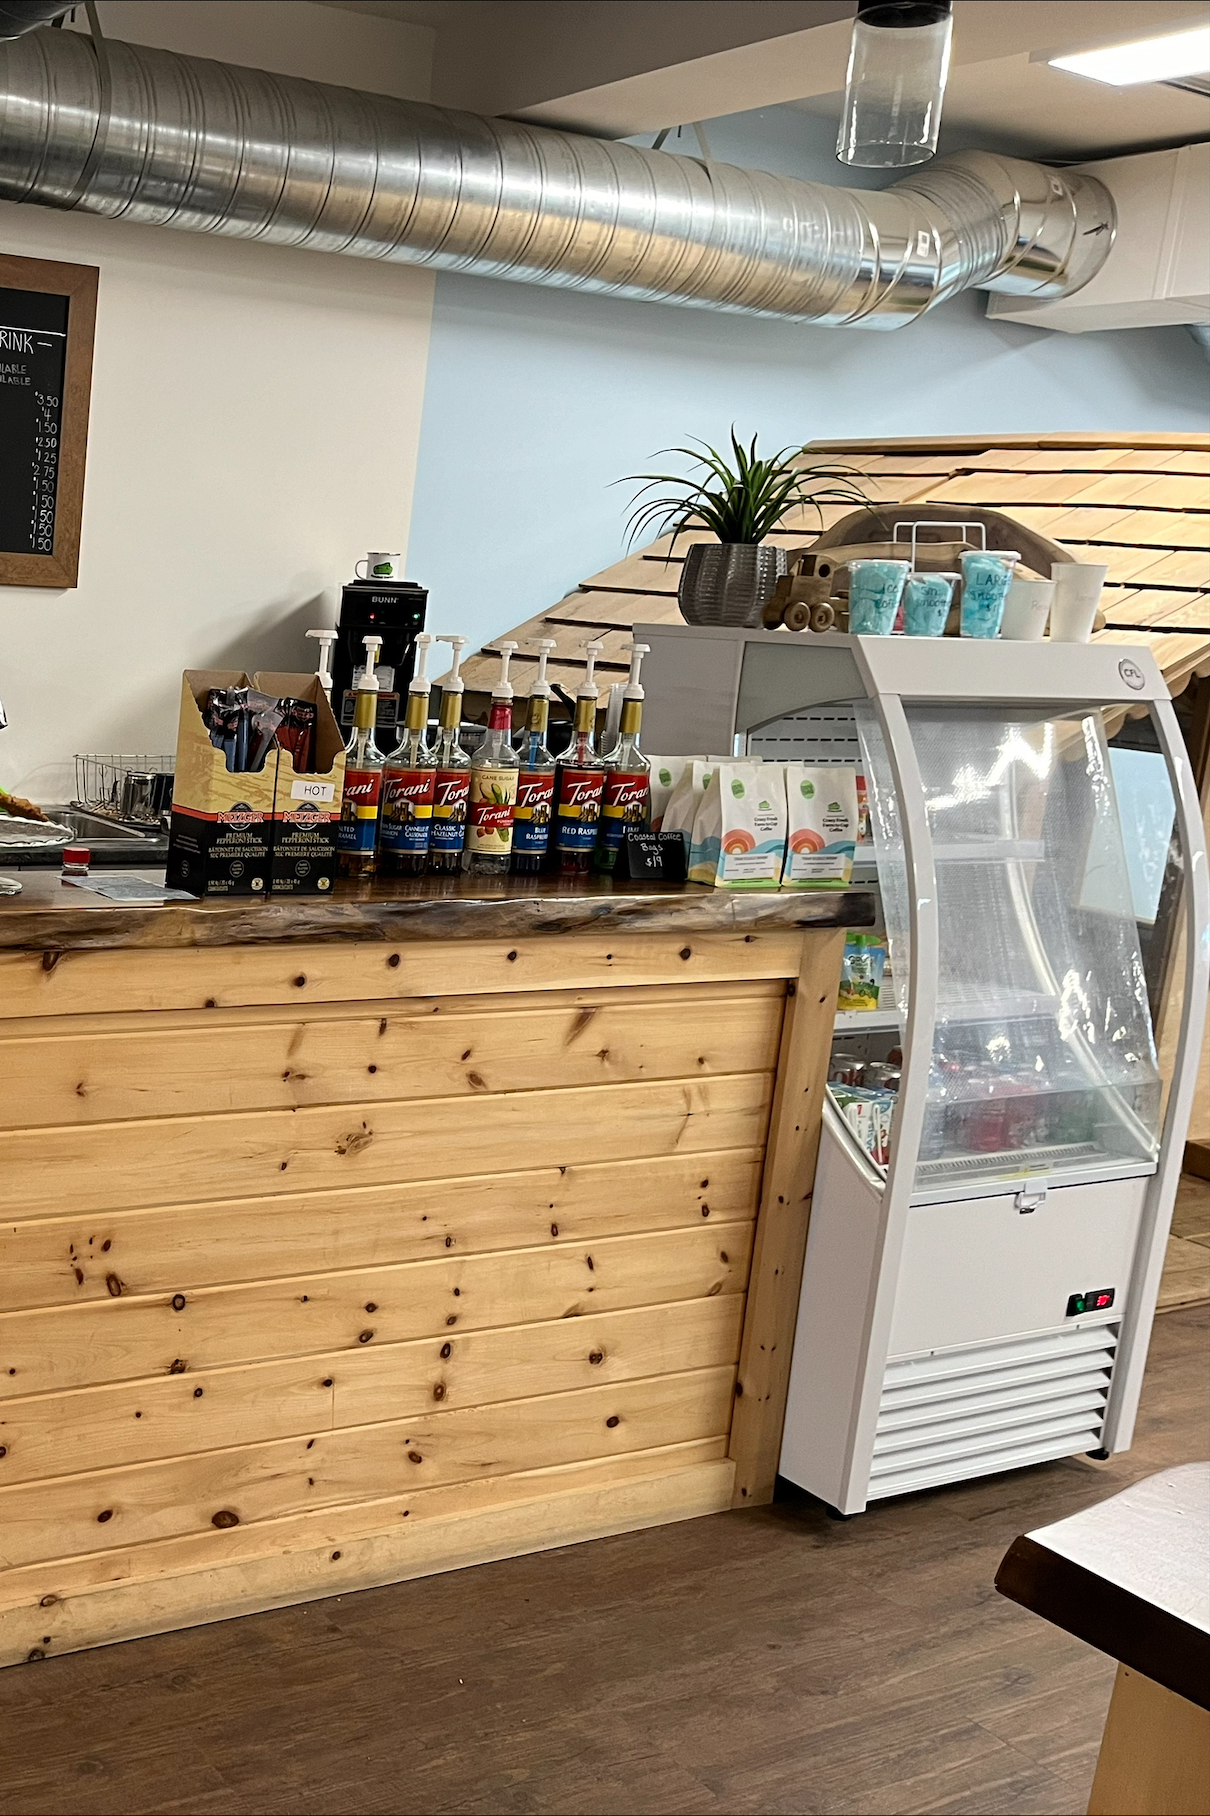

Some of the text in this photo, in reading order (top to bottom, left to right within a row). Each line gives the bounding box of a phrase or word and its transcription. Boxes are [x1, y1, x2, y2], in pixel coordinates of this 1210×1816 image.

[371, 596, 397, 604] BUNN
[304, 785, 327, 795] HOT
[383, 778, 431, 803] Torani
[438, 780, 469, 807] Tora
[611, 782, 648, 807] Toran
[477, 806, 511, 825] Torani
[628, 833, 681, 841] Coastal Coffee
[640, 842, 663, 855] Bags
[645, 856, 663, 867] $19
